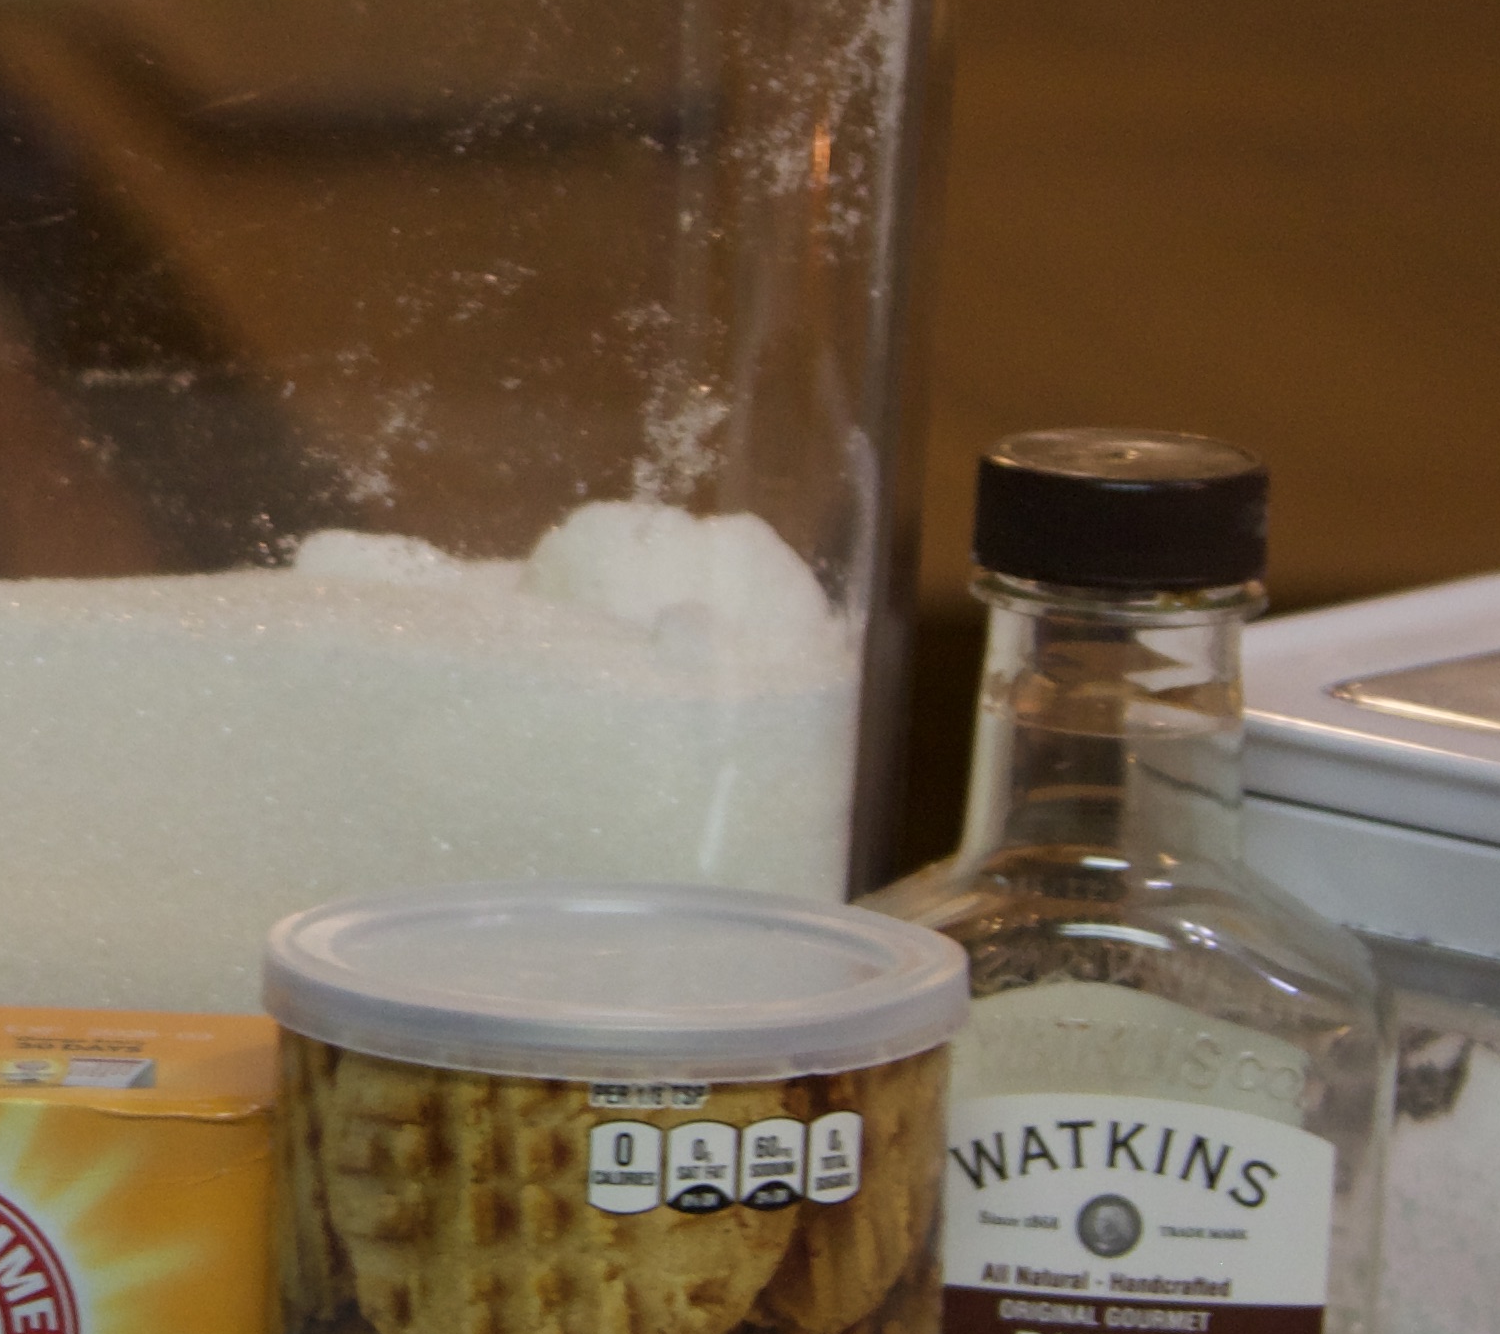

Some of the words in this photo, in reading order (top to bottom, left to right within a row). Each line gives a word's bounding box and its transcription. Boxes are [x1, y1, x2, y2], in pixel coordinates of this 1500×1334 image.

[615, 1132, 634, 1166] 0
[948, 1118, 1281, 1210] WATKINS
[981, 1262, 1009, 1284] All
[1014, 1265, 1091, 1291] Natural
